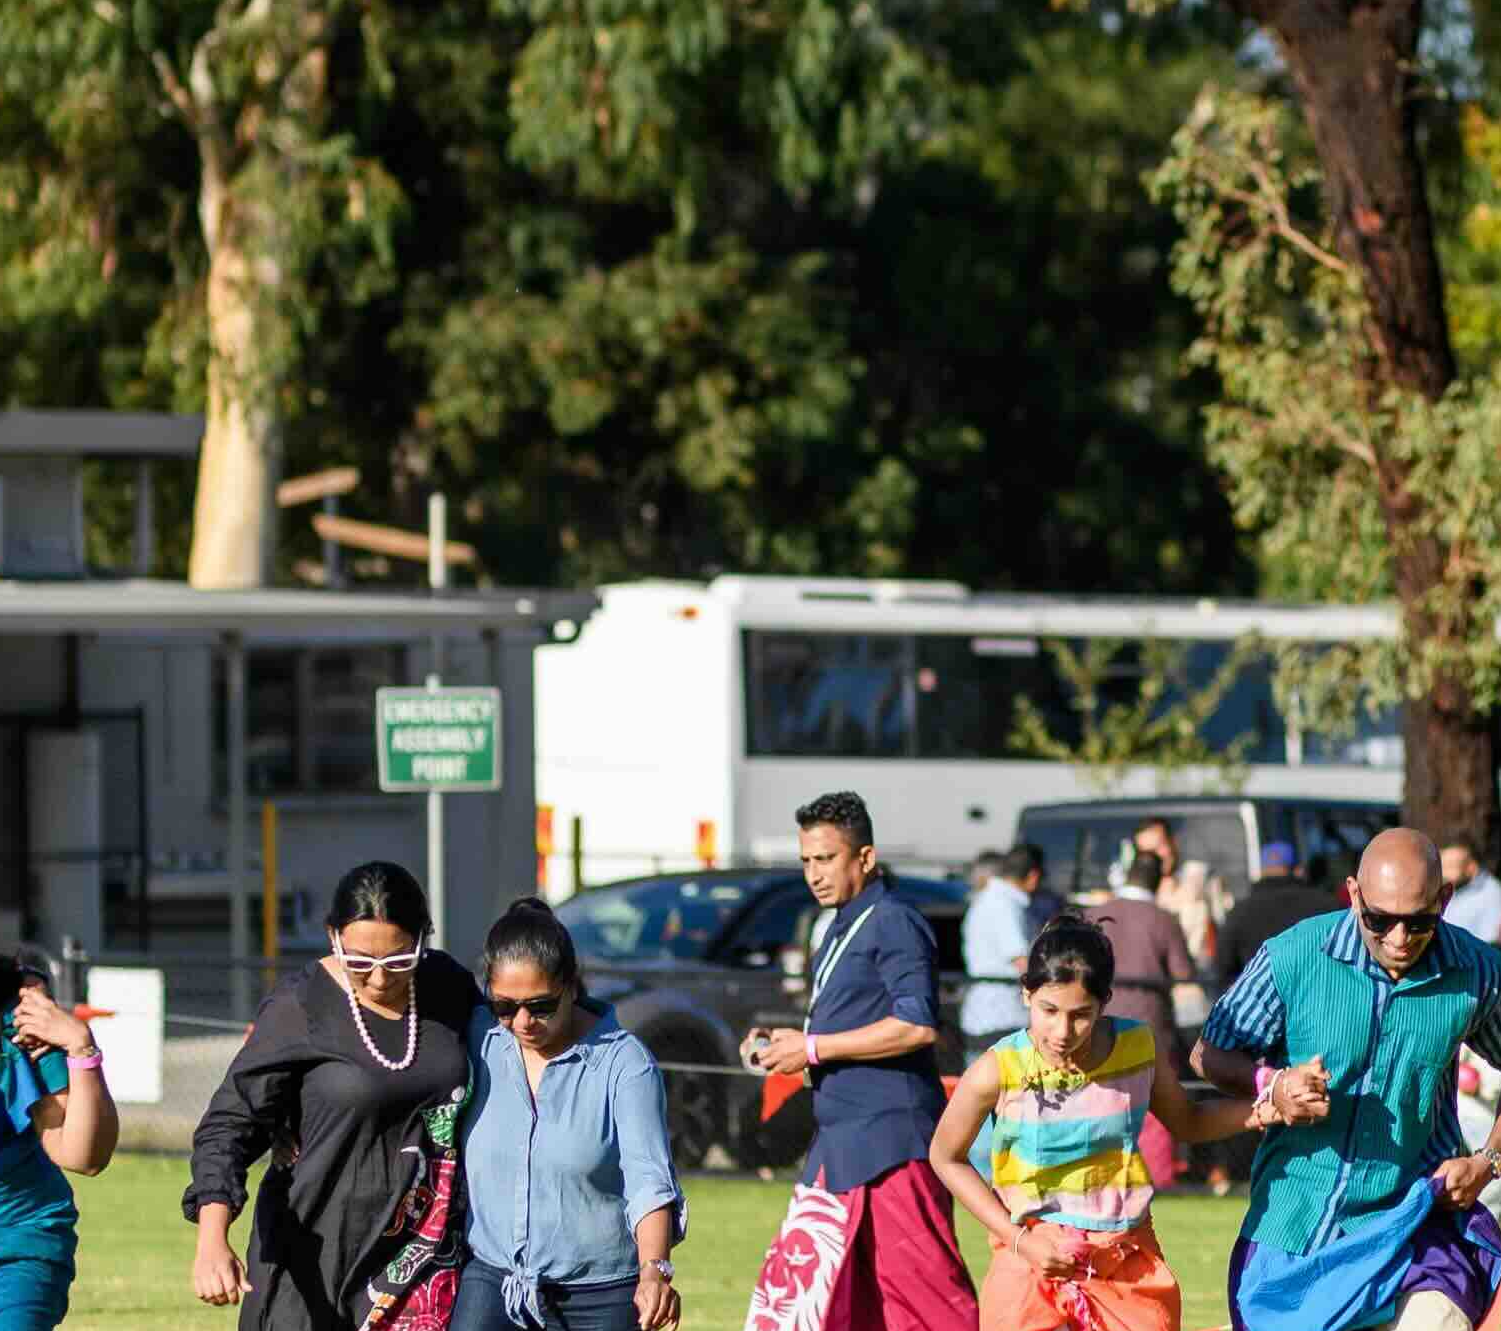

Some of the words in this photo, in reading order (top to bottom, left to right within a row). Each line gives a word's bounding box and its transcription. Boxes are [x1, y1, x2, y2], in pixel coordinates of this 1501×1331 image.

[385, 700, 491, 724] EMERGENCY
[391, 729, 486, 752] ASSEMBLY
[412, 755, 467, 780] POINT
